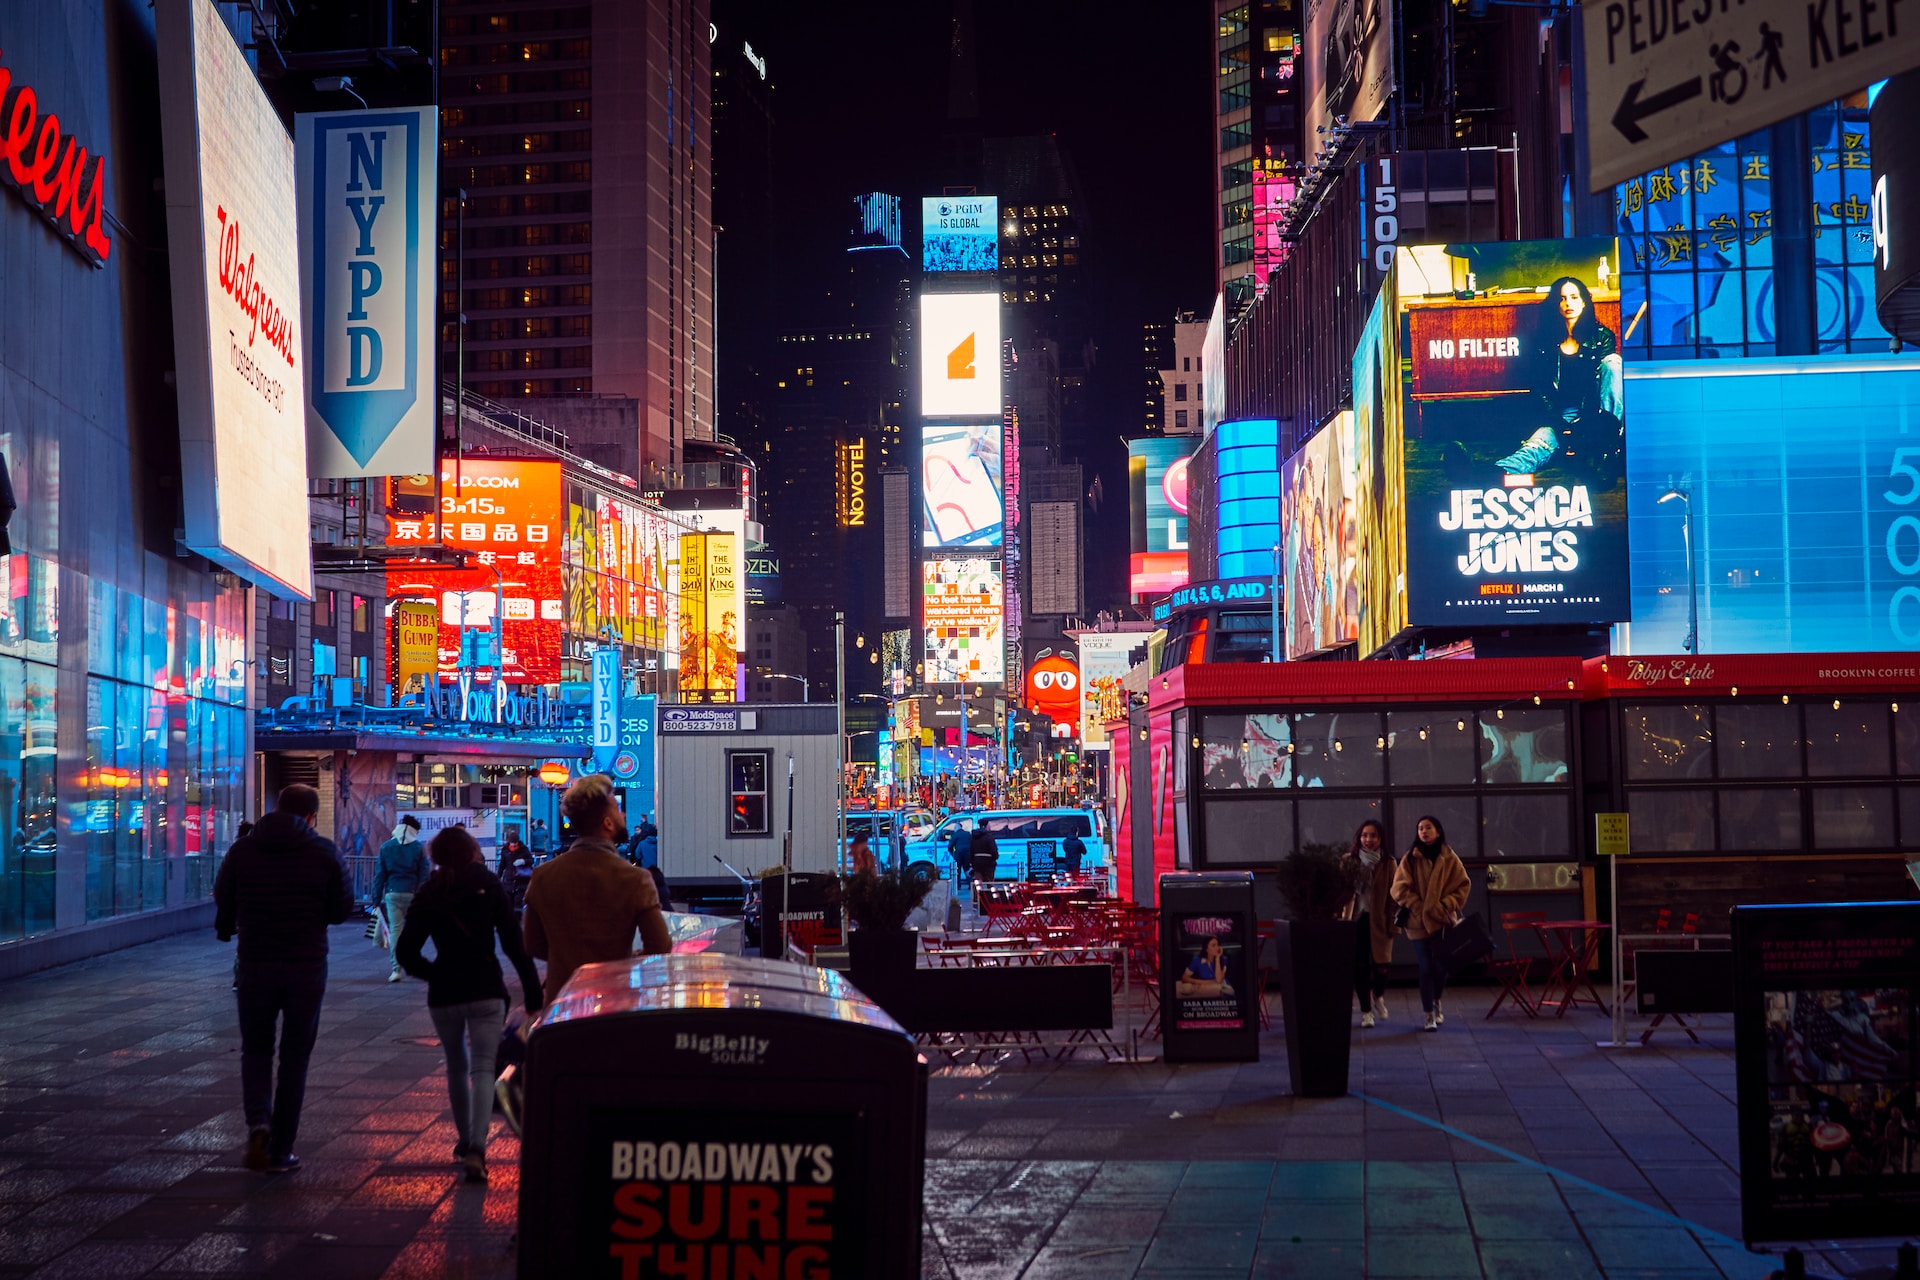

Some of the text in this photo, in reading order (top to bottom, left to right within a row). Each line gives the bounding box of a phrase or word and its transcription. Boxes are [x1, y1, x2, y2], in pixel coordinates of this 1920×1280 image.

[954, 203, 984, 215] PGIM
[1375, 158, 1398, 272] 1500
[940, 217, 981, 229] IS GLOBAL
[347, 131, 387, 387] NYPD
[217, 203, 295, 368] Walgreens
[1428, 336, 1520, 360] NO FILTER
[229, 329, 254, 384] Trusted
[452, 475, 520, 489] D.COM
[848, 436, 865, 526] NOVOTEL
[1438, 485, 1594, 532] JESSICA
[713, 555, 728, 563] THE
[1457, 530, 1580, 576] JONES
[711, 564, 732, 576] LION
[709, 577, 735, 592] KING
[1480, 583, 1564, 595] NETFLIX MARCH 8
[926, 594, 982, 604] No feet have
[1189, 587, 1198, 605] 4,
[1198, 586, 1209, 603] 5,
[1211, 585, 1225, 602] 6,
[1226, 582, 1266, 599] AND
[1562, 596, 1600, 604] SERIES
[926, 605, 1000, 615] wandered where
[401, 610, 436, 628] BUBBA
[926, 616, 991, 627] you've walked.
[404, 629, 434, 647] GUMP
[403, 656, 435, 664] COMPANY
[405, 649, 432, 657] SHRIMP
[1626, 659, 1715, 686] Toby's Estate
[1818, 668, 1916, 679] BROOKLYN COFFEE
[459, 674, 494, 722] YORK
[497, 679, 538, 726] POLICE
[598, 654, 612, 744] NYPD
[689, 710, 736, 722] ModSpace
[664, 721, 735, 731] 800-523-7918
[778, 911, 825, 921] BOADWAY'S
[674, 1032, 770, 1053] BigBelly
[711, 1052, 756, 1065] SOLAR
[611, 1140, 834, 1184] BROADWAY'S
[609, 1182, 835, 1242] SURE
